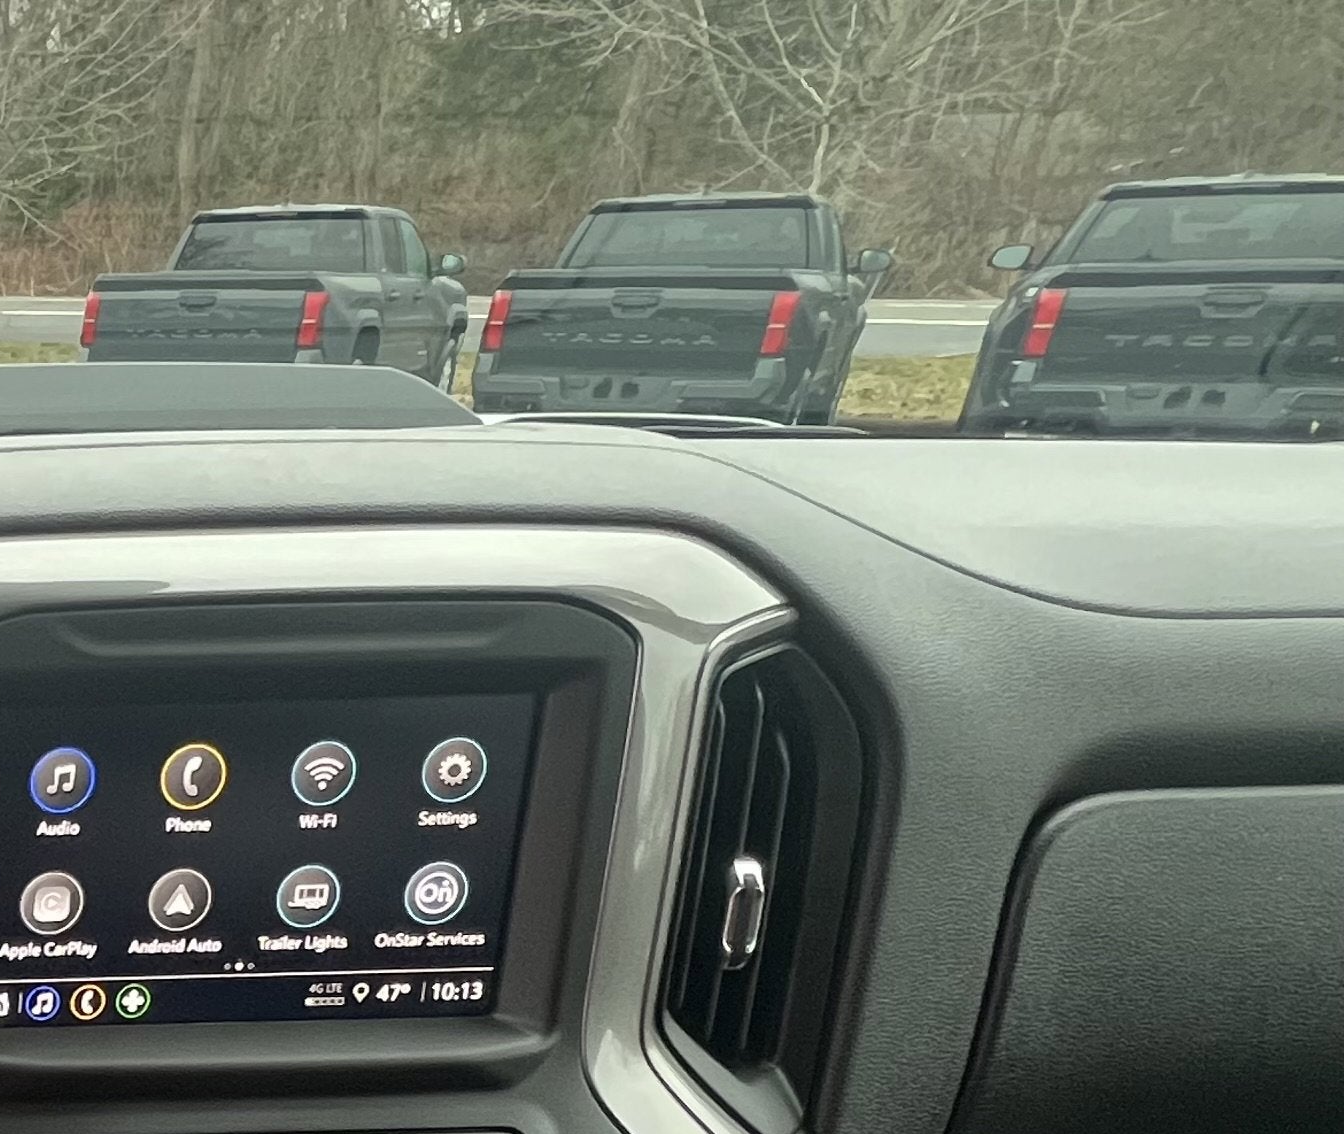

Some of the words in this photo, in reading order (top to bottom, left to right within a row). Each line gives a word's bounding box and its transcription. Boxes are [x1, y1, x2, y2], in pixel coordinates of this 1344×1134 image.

[542, 332, 716, 345] TACOMA
[36, 819, 81, 836] Audio
[165, 817, 212, 834] Phone
[299, 813, 338, 829] Wi-Fi
[417, 810, 478, 828] Settings
[128, 938, 186, 954] Android
[187, 938, 222, 953] Auto
[257, 935, 303, 951] Trailer
[304, 935, 348, 952] Lights
[374, 932, 425, 948] OnStar
[425, 931, 486, 947] Services
[43, 940, 98, 960] CarPlay
[309, 983, 324, 994] 4G
[325, 982, 343, 994] LTE
[432, 981, 484, 1001] 10:13
